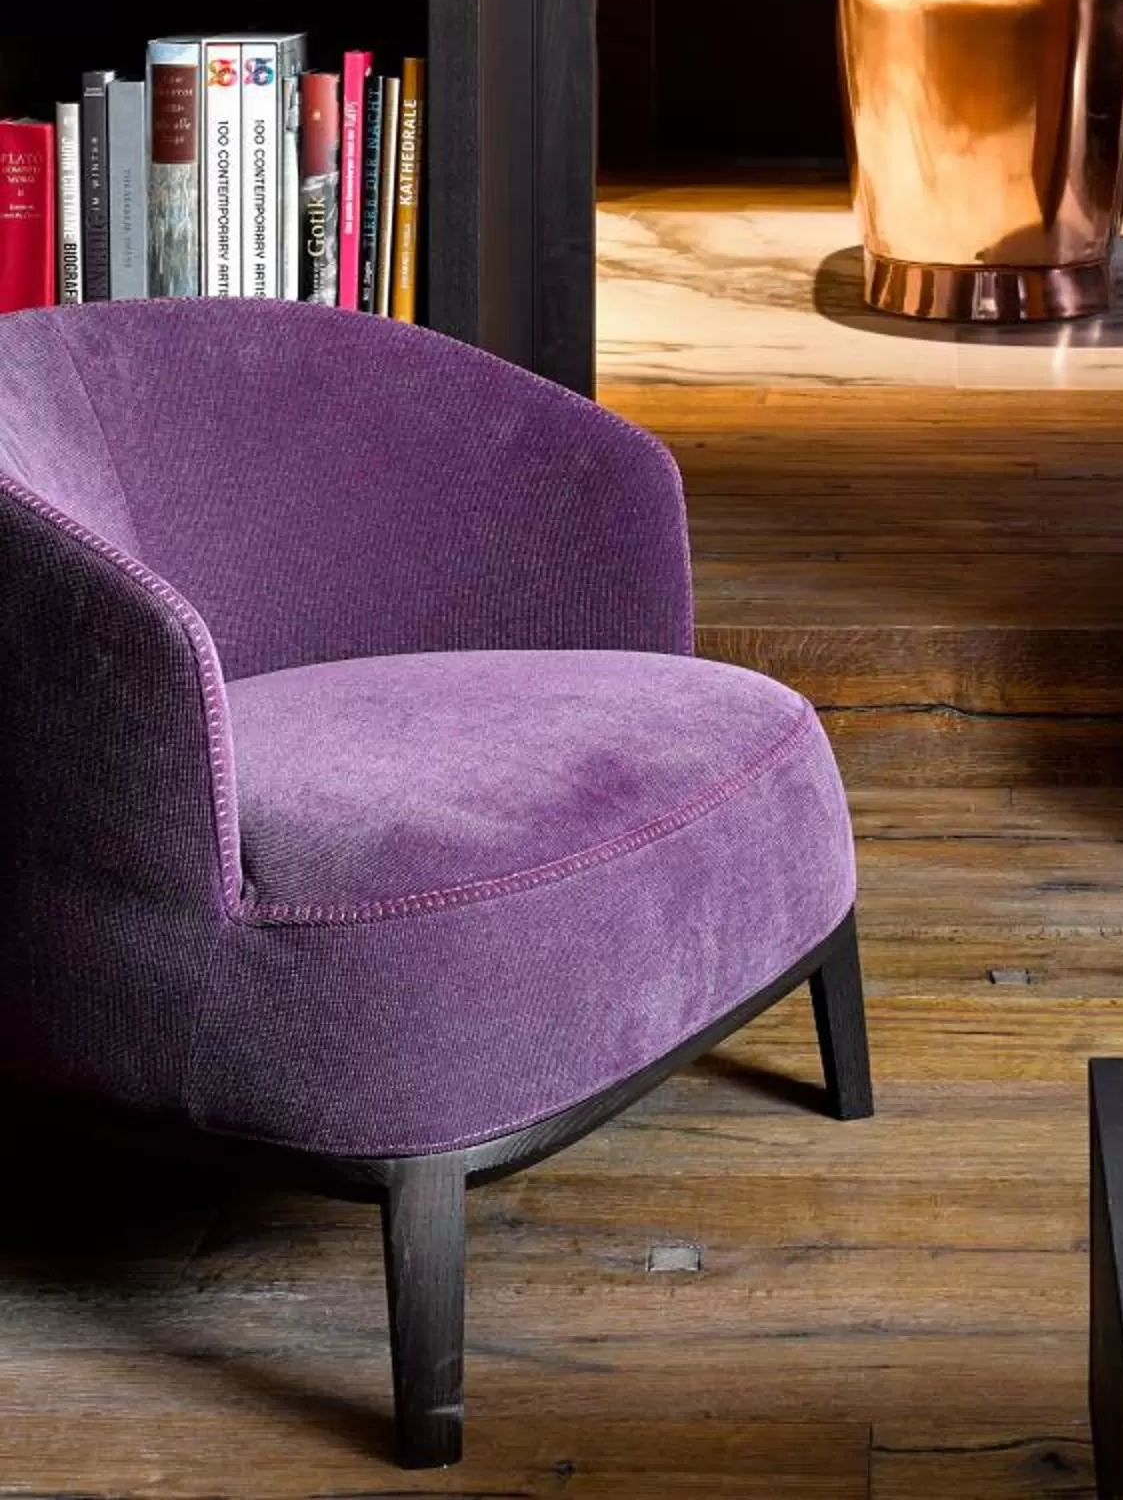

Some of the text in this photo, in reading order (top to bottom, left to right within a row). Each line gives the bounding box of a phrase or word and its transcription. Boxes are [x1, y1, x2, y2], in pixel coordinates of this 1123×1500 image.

[217, 121, 230, 147] 100
[253, 119, 265, 146] 100
[400, 100, 417, 206] KATHEDRALE
[217, 151, 230, 261] CONTEMPORARY
[253, 149, 265, 259] CONTEMPORARY
[307, 195, 326, 257] Gotik
